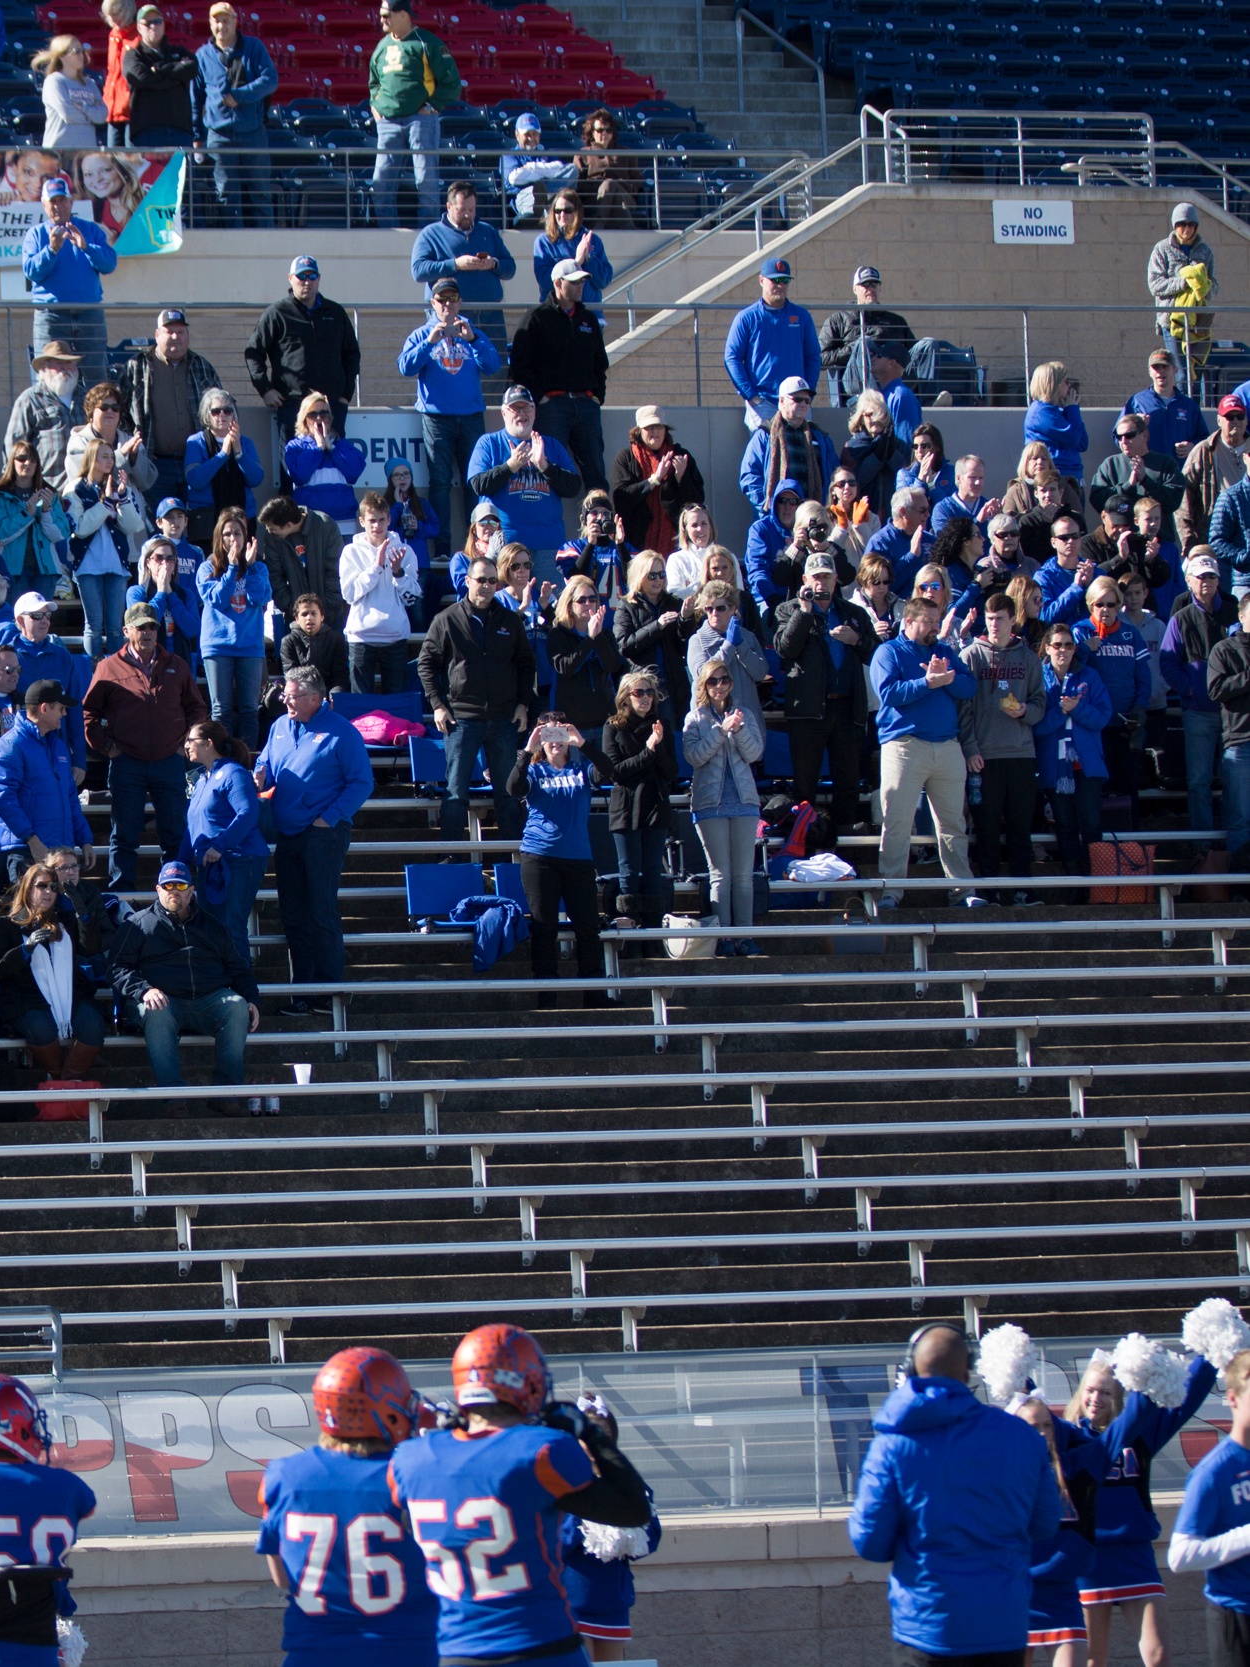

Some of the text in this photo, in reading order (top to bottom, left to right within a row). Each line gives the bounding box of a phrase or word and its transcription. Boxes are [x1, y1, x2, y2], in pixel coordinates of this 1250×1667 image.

[1, 211, 33, 224] THE
[1023, 207, 1043, 219] NO
[1000, 224, 1068, 237] STANDING
[352, 437, 426, 463] DENT
[979, 667, 1026, 680] AGGIES
[407, 1497, 532, 1601] 52
[285, 1512, 406, 1616] 76
